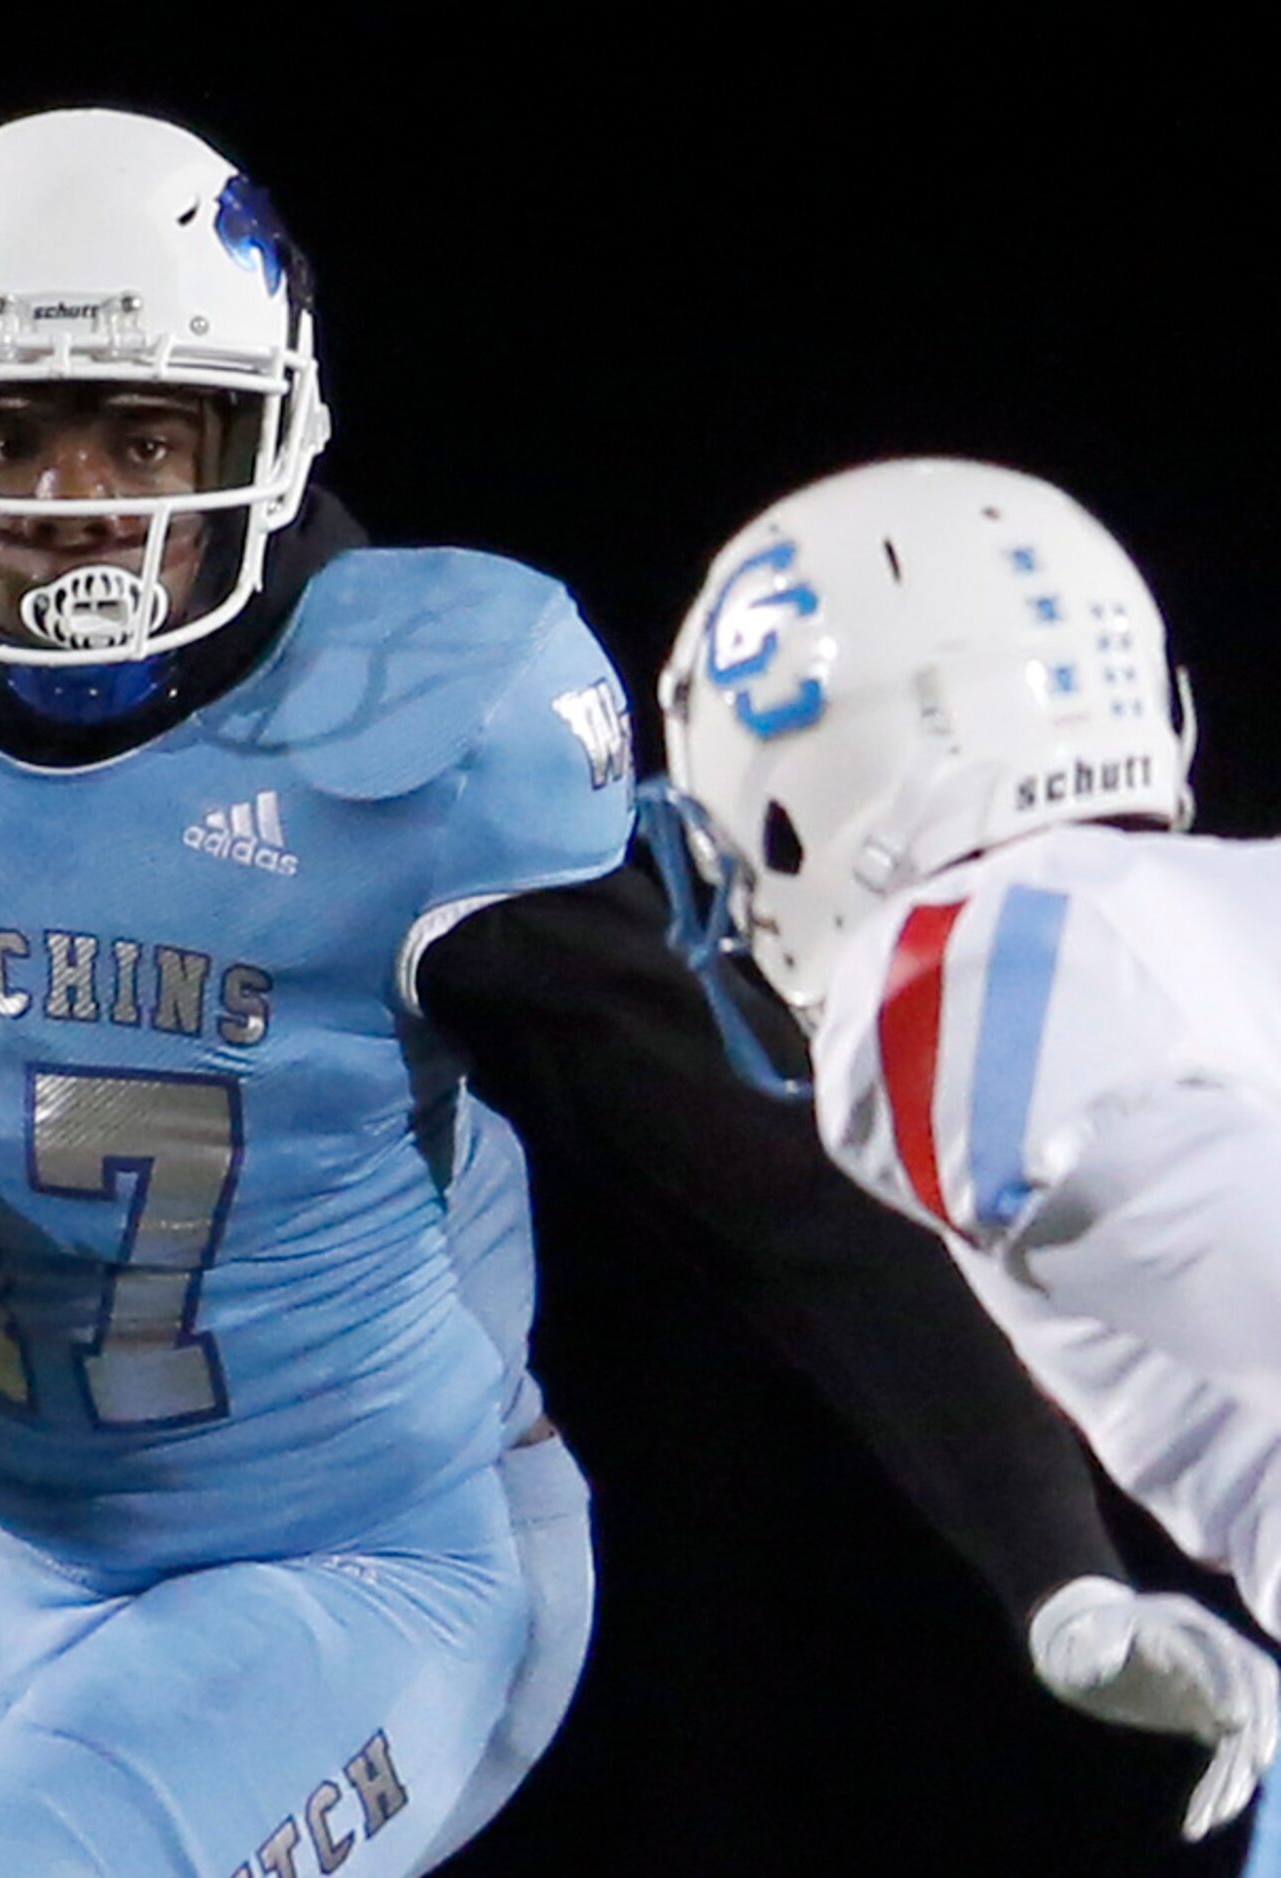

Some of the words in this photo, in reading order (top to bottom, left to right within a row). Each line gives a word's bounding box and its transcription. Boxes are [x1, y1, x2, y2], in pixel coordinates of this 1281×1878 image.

[32, 301, 100, 320] schutt
[1017, 756, 1151, 811] schutt
[182, 825, 298, 876] adidas
[229, 1727, 410, 1878] TCH
